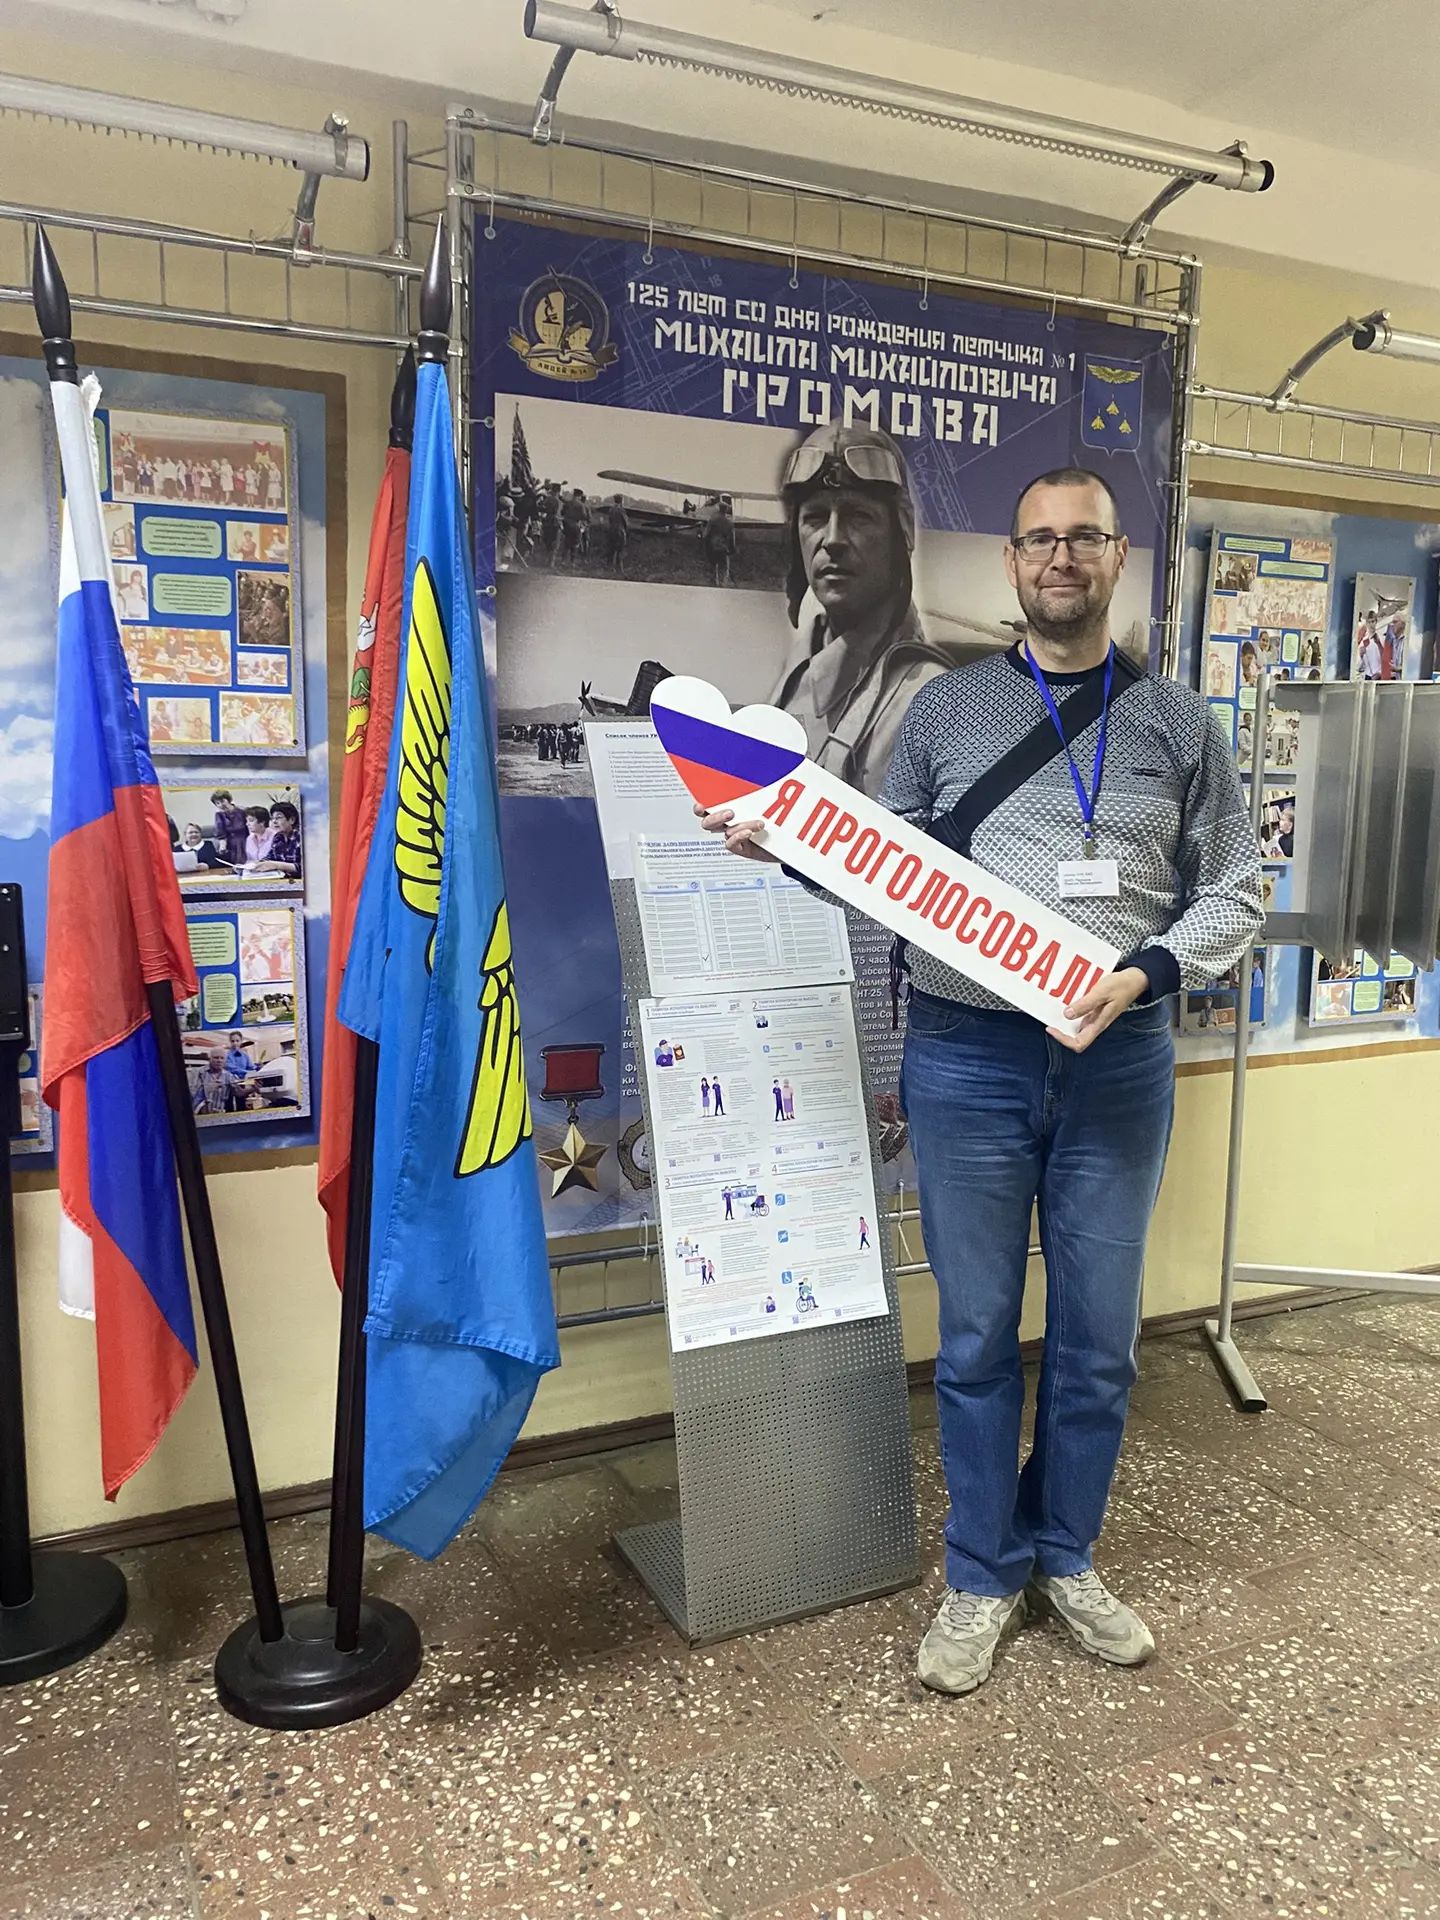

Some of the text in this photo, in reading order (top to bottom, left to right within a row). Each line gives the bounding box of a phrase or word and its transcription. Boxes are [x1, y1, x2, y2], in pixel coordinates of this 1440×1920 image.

[628, 281, 669, 309] 125
[654, 317, 818, 371] МИХАИЛА
[723, 368, 999, 447] ГРОМОВА
[763, 778, 806, 826] Я
[869, 956, 890, 964] часо
[664, 1177, 671, 1188] 3
